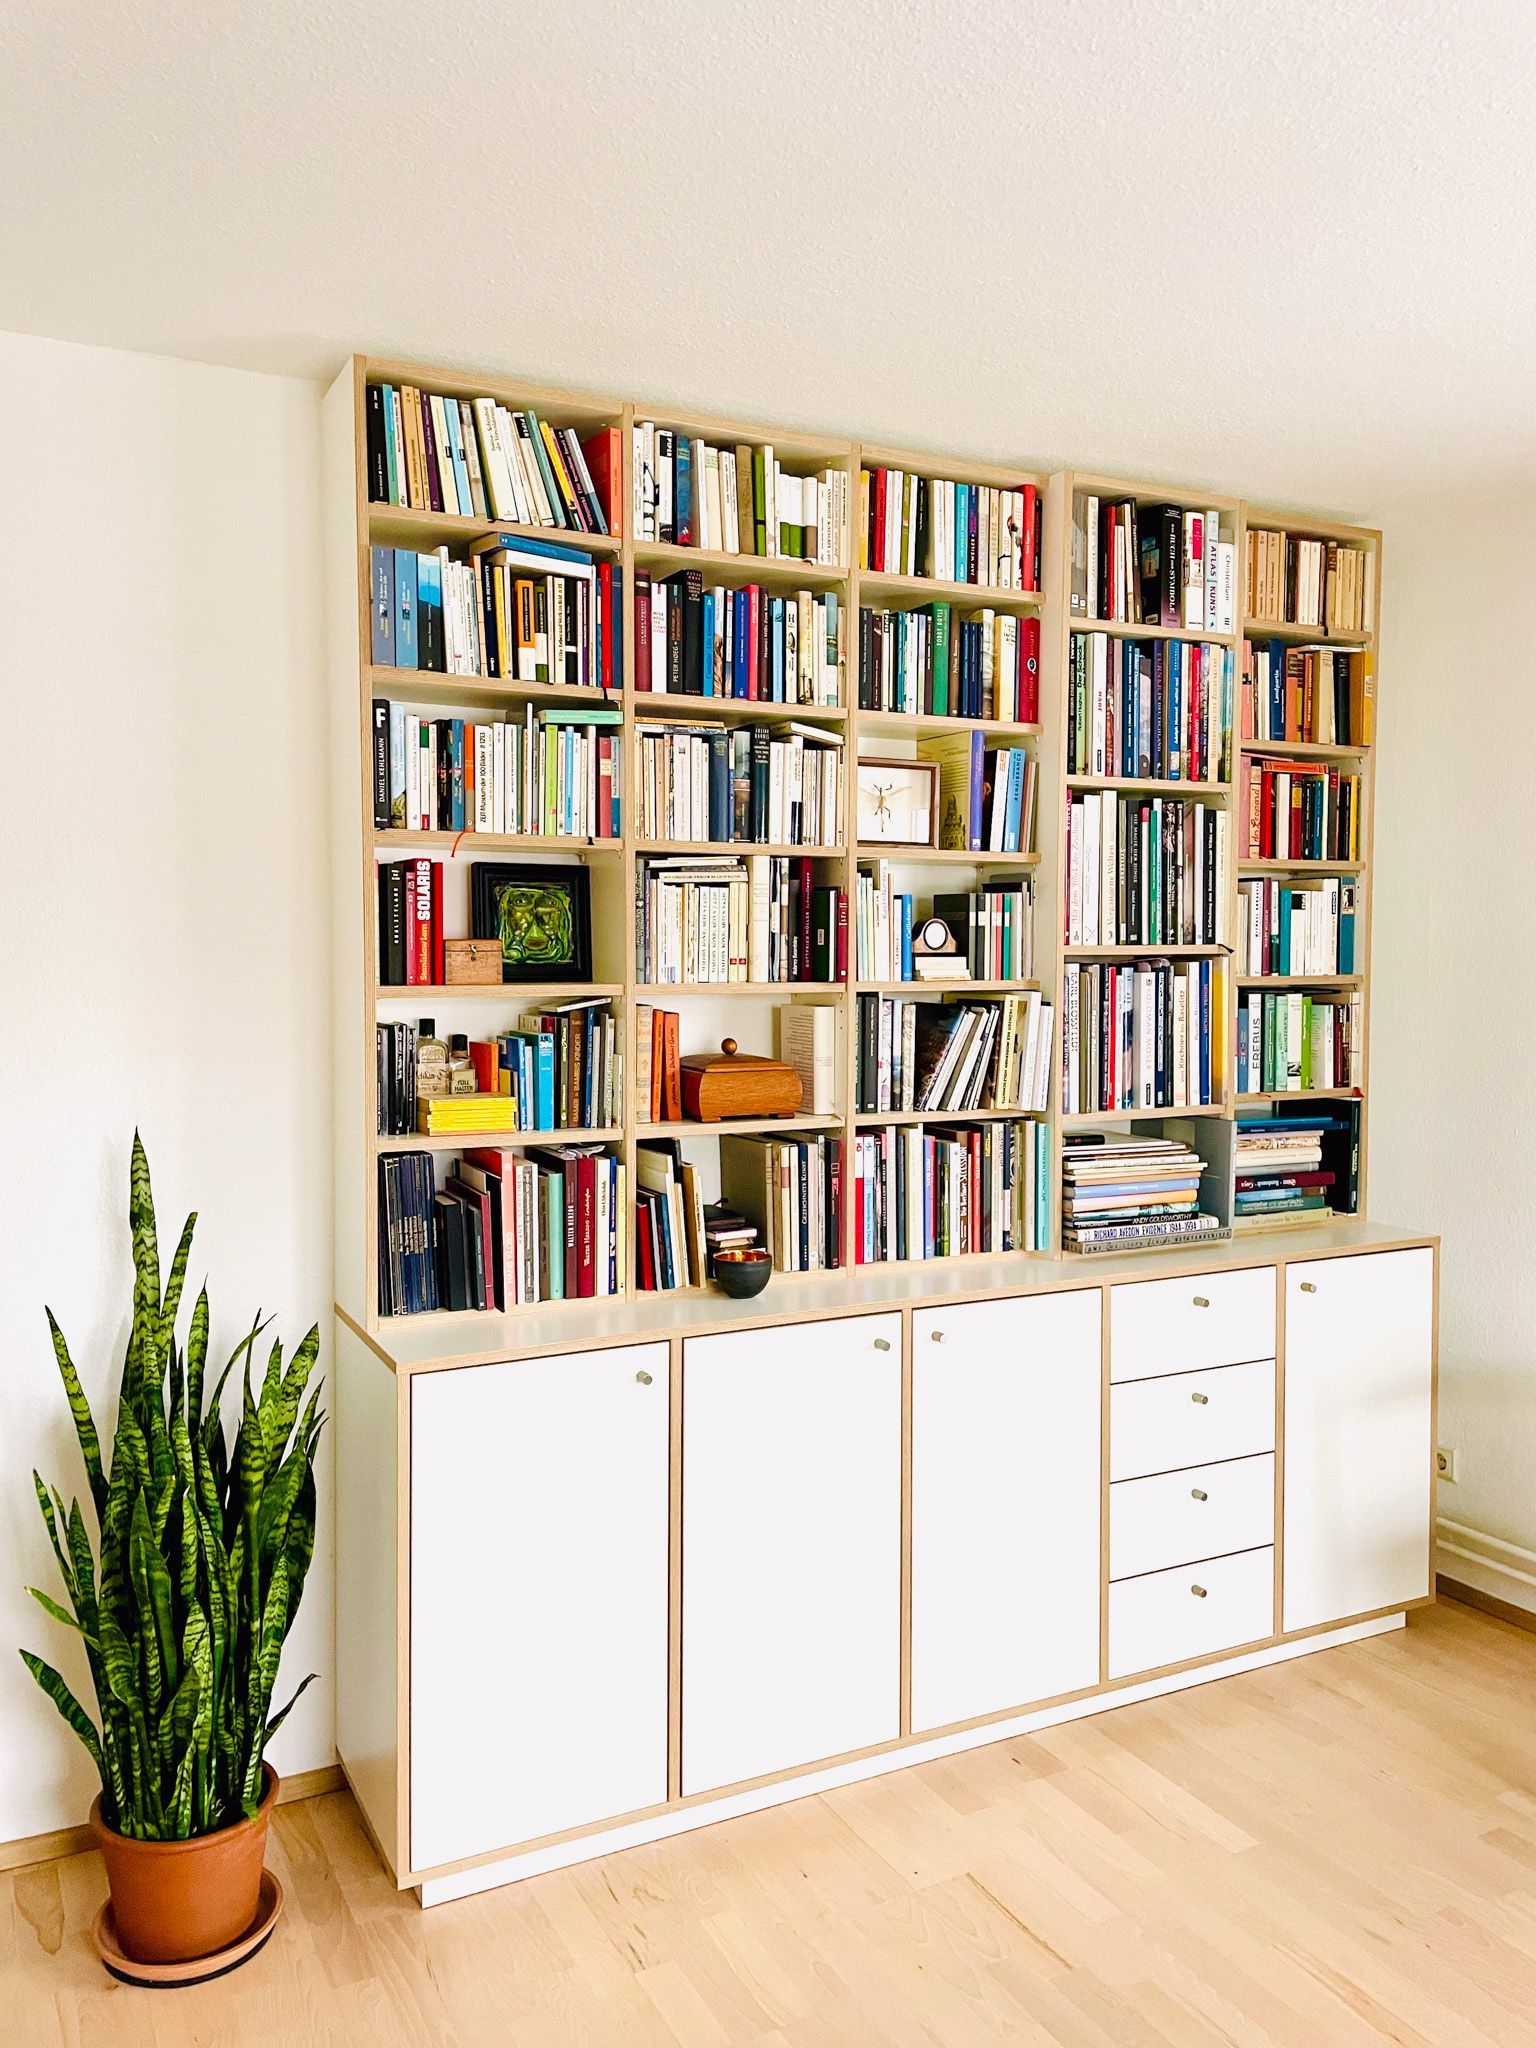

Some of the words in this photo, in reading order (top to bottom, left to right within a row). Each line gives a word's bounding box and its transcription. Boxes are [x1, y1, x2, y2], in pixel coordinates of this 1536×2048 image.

[1157, 692, 1162, 700] IN
[378, 738, 386, 776] KEHLMANN
[1014, 753, 1022, 801] RENAISSANCE
[378, 778, 386, 802] DANIEL
[1251, 788, 1260, 822] Leopard
[416, 860, 431, 920] SOLARIS
[420, 924, 428, 940] Lem
[1070, 972, 1078, 996] KARL
[1252, 1018, 1260, 1069] EREBUS
[572, 1098, 580, 1122] BAMBI
[1132, 1216, 1149, 1224] ANDY
[1149, 1213, 1193, 1222] GOLDSWORTHY
[1094, 1230, 1118, 1241] RICHARD
[1118, 1228, 1140, 1239] AVEDON
[1142, 1224, 1167, 1236] EVIDENCE
